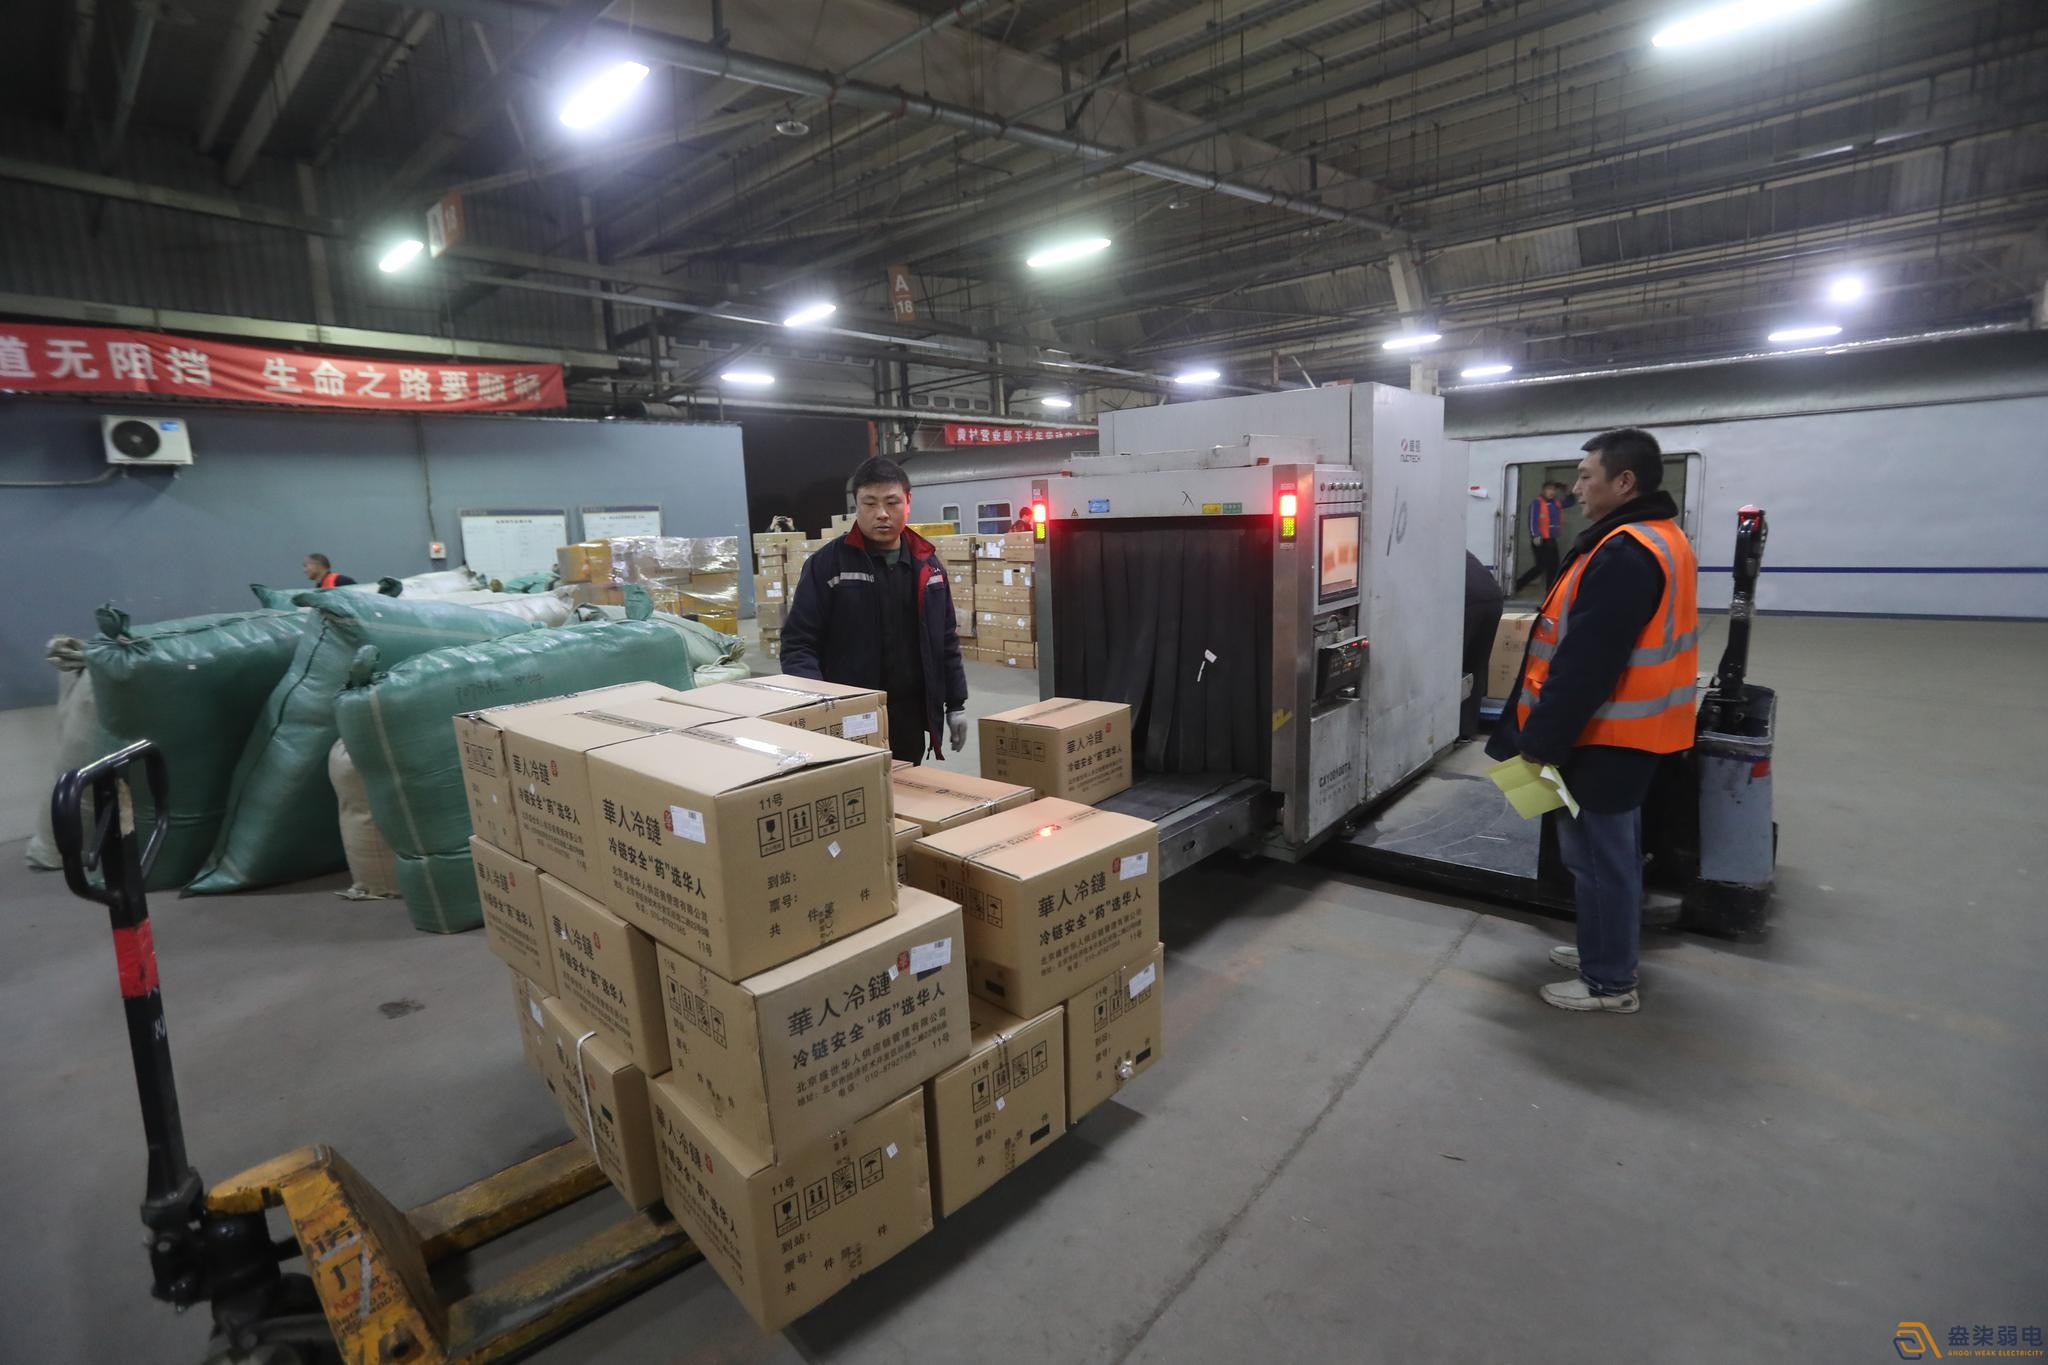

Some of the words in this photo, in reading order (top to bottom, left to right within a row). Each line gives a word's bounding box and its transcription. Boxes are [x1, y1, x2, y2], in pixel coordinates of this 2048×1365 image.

[895, 274, 909, 291] A
[897, 300, 913, 313] 18
[262, 356, 542, 402] 生命之路要顺畅
[602, 798, 663, 847] 華人冷鏈
[758, 792, 784, 811] 11号
[607, 836, 707, 900] 冷链安全“药”选华人
[769, 922, 782, 939] 共
[859, 887, 871, 903] 件
[1037, 871, 1107, 919] 華人冷鏈
[1039, 886, 1142, 947] 冷链安全“药”选华人
[697, 939, 713, 958] 11号
[786, 970, 891, 1038] 華人冷鏈
[792, 981, 946, 1070] 冷链安全“药”选华人
[931, 1031, 951, 1049] 11号
[970, 1058, 991, 1077] 11号
[772, 1175, 795, 1196] 11号
[823, 1255, 836, 1272] 件
[877, 1222, 889, 1238] 件
